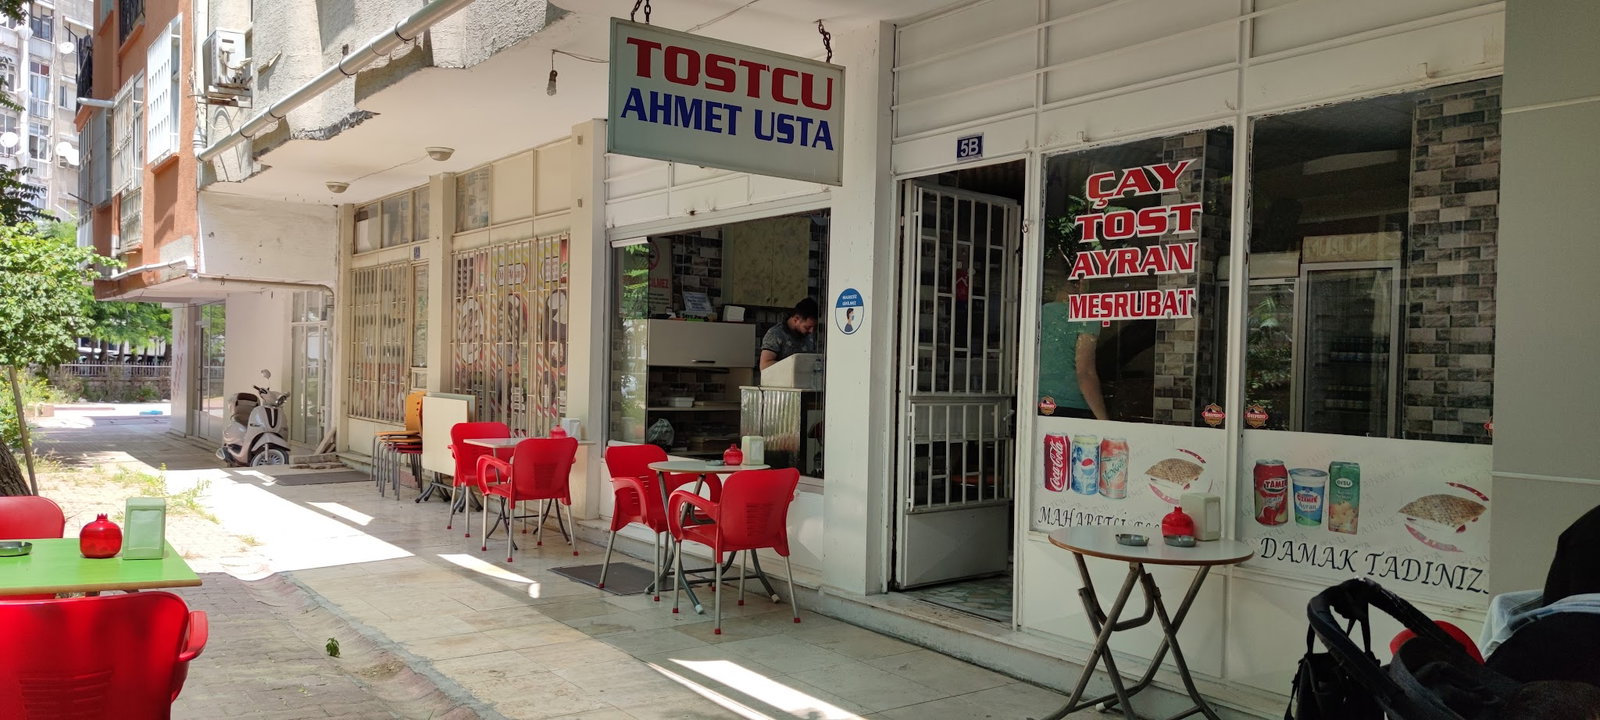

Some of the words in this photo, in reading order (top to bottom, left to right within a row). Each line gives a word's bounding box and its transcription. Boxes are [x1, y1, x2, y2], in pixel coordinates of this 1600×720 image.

[626, 37, 833, 110] TOSTCU
[620, 87, 742, 135] AHMET
[754, 109, 834, 151] USTA
[960, 138, 979, 156] 5B
[1086, 158, 1197, 209] ÇAY
[1075, 202, 1203, 244] TOST
[1067, 242, 1198, 281] AYRAN
[1067, 288, 1197, 327] MEŞRUBAT
[1260, 537, 1359, 573] DAMAK
